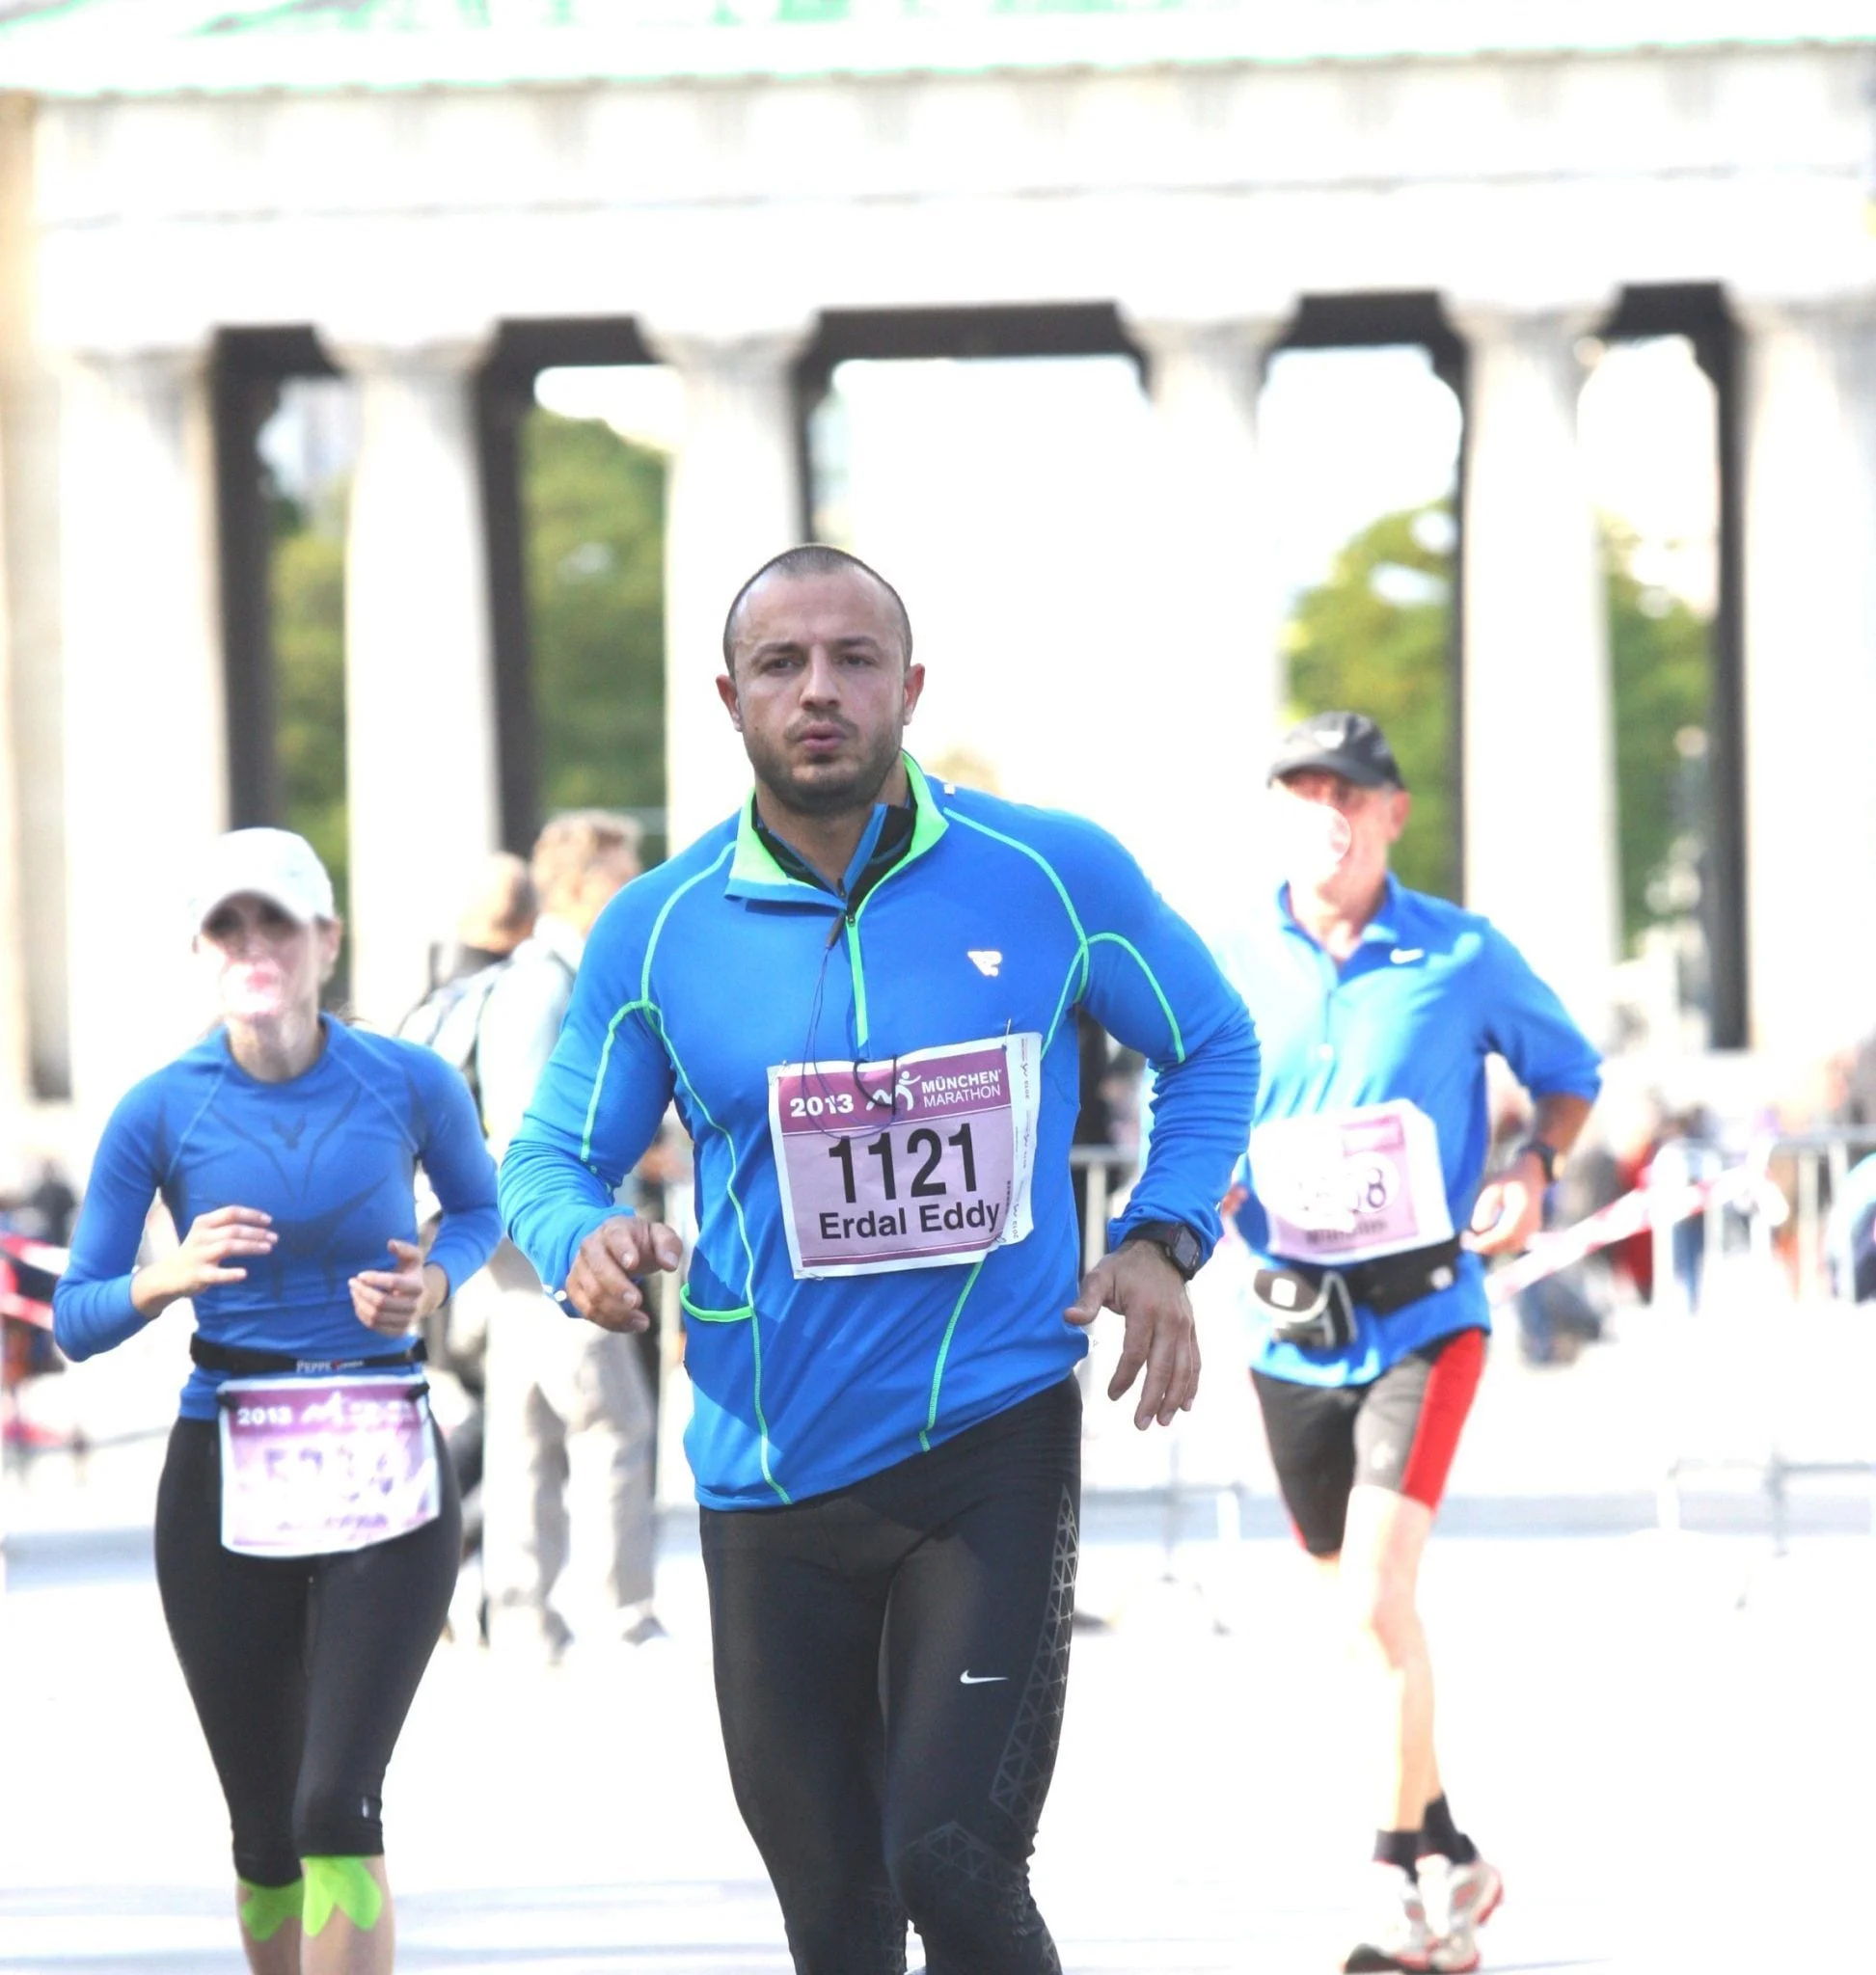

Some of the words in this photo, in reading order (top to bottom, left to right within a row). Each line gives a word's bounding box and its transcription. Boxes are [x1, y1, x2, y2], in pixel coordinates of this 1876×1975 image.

[921, 1069, 1000, 1094] MÜNCHEN
[790, 1094, 854, 1117] 2013
[923, 1084, 1001, 1108] MARATHON
[829, 1123, 977, 1204] 1121
[820, 1207, 907, 1240] Erdal
[919, 1200, 1000, 1232] Eddy
[237, 1404, 292, 1426] 2013
